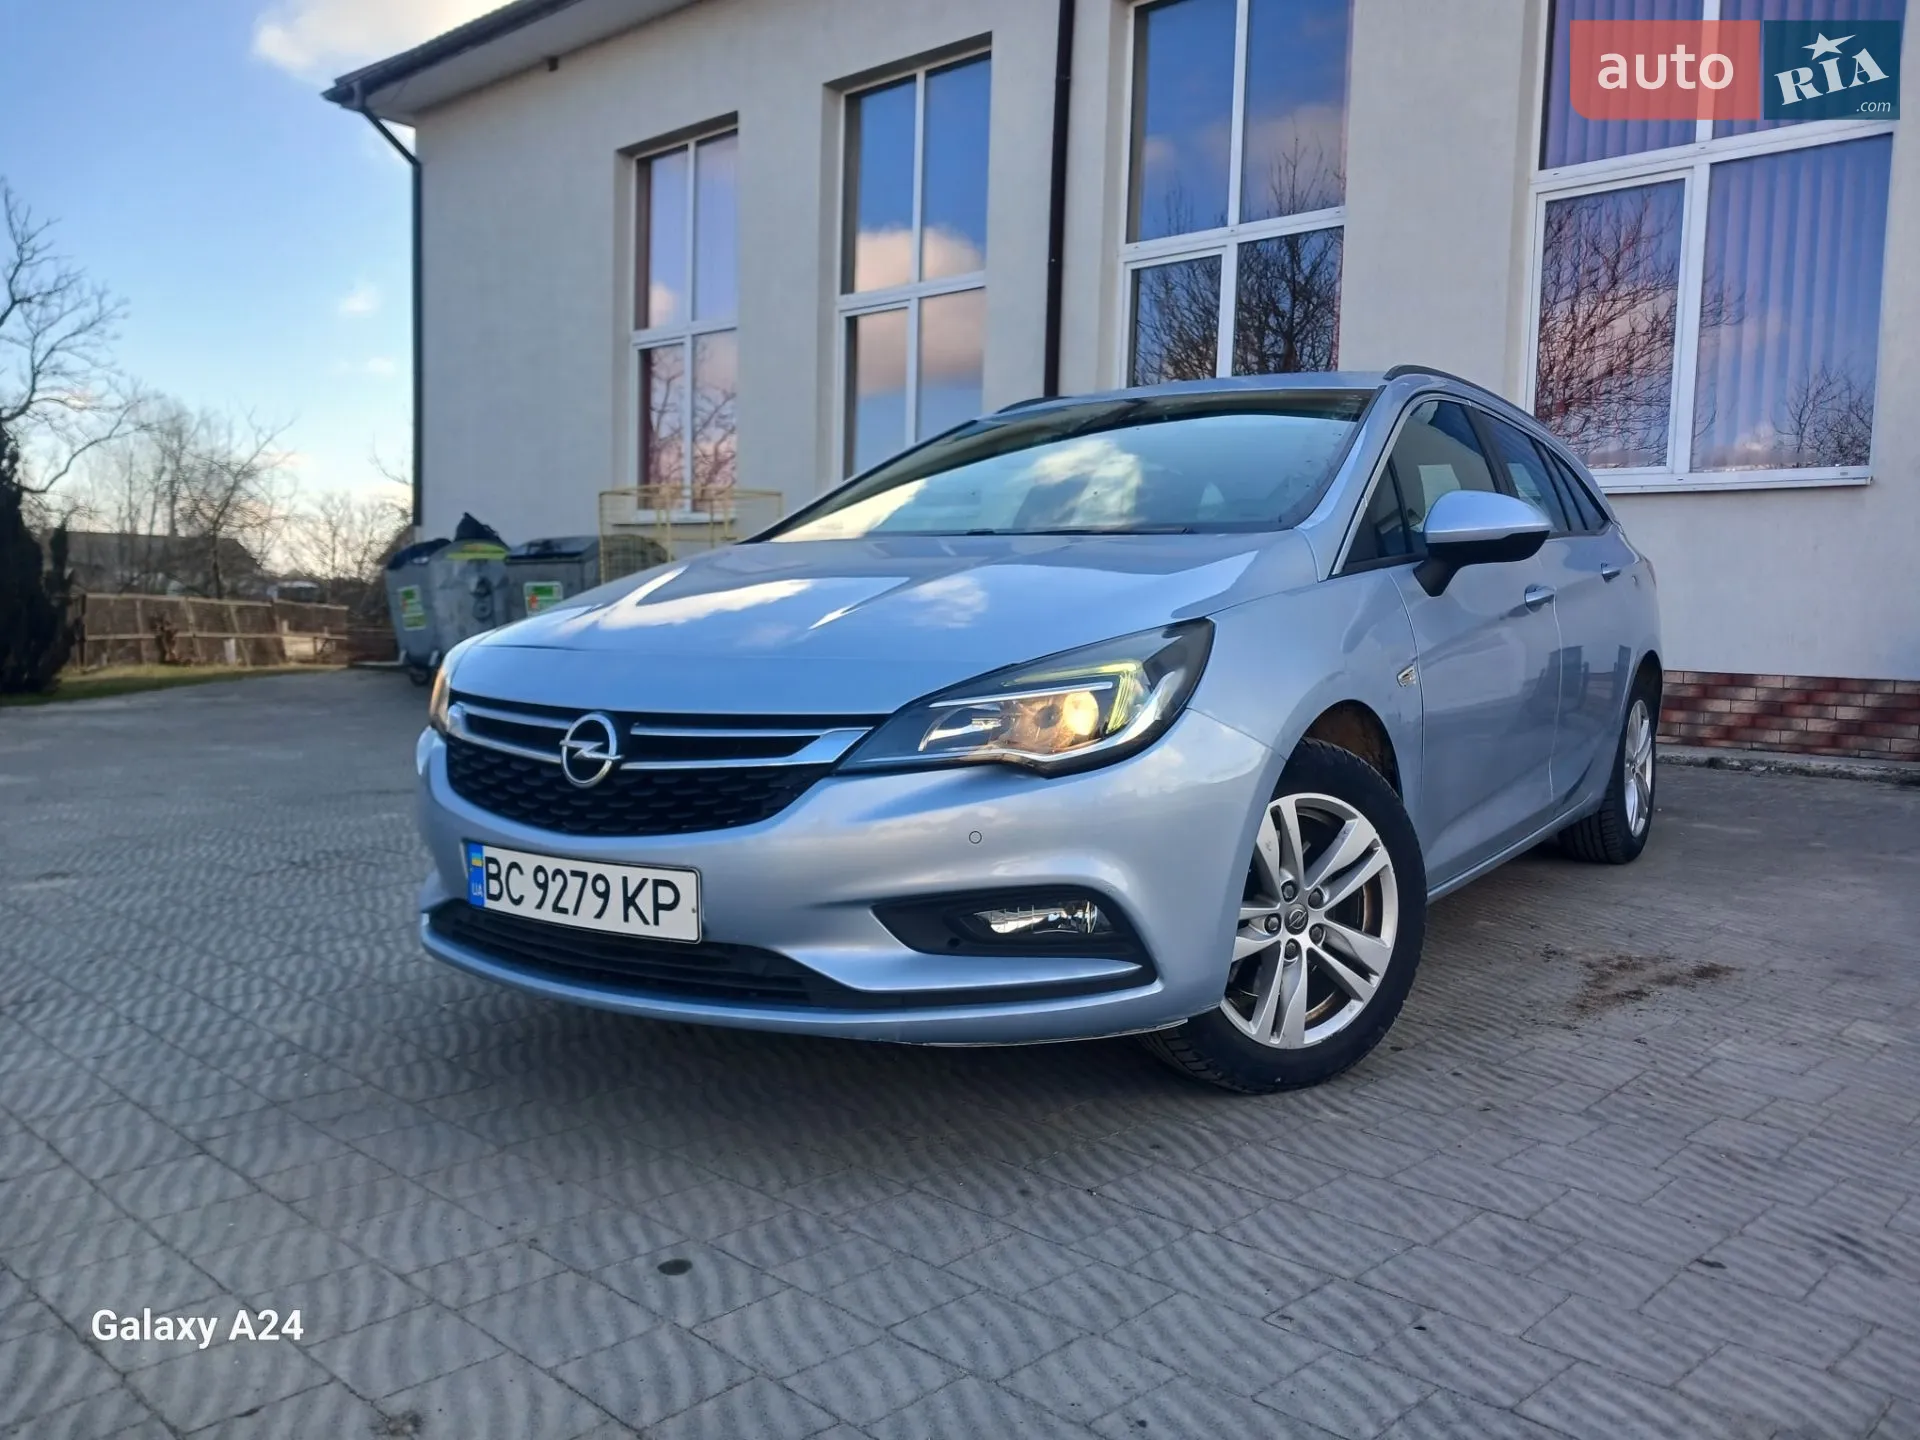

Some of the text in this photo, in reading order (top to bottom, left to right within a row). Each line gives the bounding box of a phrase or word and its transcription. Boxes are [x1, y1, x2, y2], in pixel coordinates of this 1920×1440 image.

[472, 883, 483, 897] UA
[485, 856, 681, 926] BC 9279 KP
